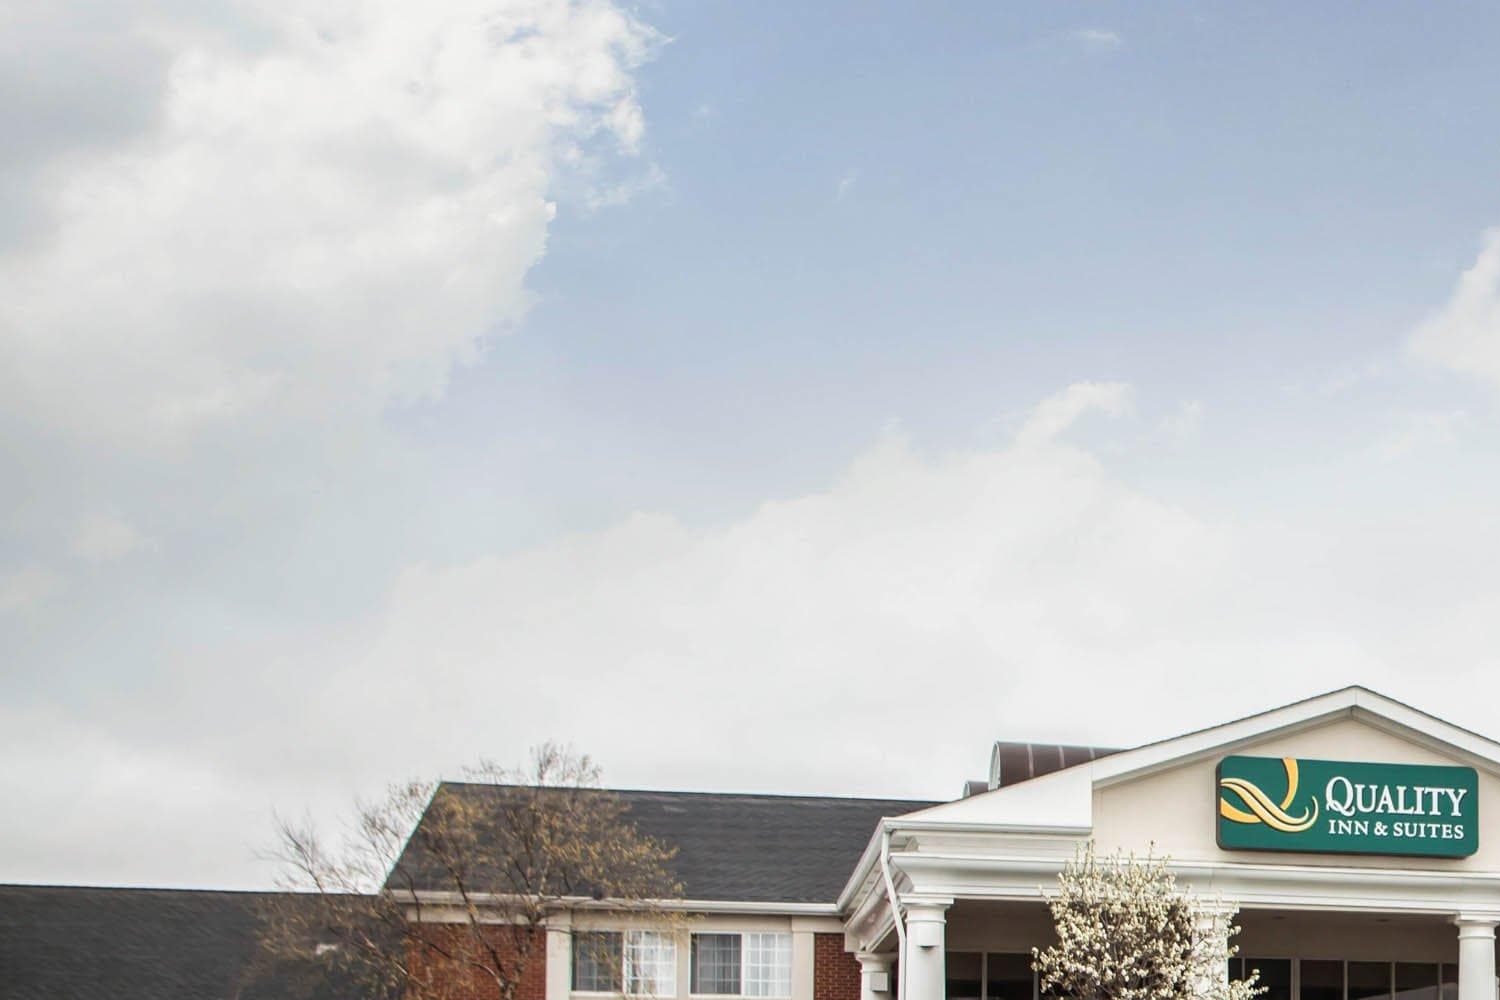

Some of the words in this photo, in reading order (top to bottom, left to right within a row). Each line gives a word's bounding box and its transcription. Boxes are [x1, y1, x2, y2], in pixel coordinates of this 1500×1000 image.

[1325, 776, 1467, 816] QUALITY
[1328, 819, 1369, 836] INN
[1374, 821, 1388, 836] &
[1393, 823, 1464, 840] SUITES
